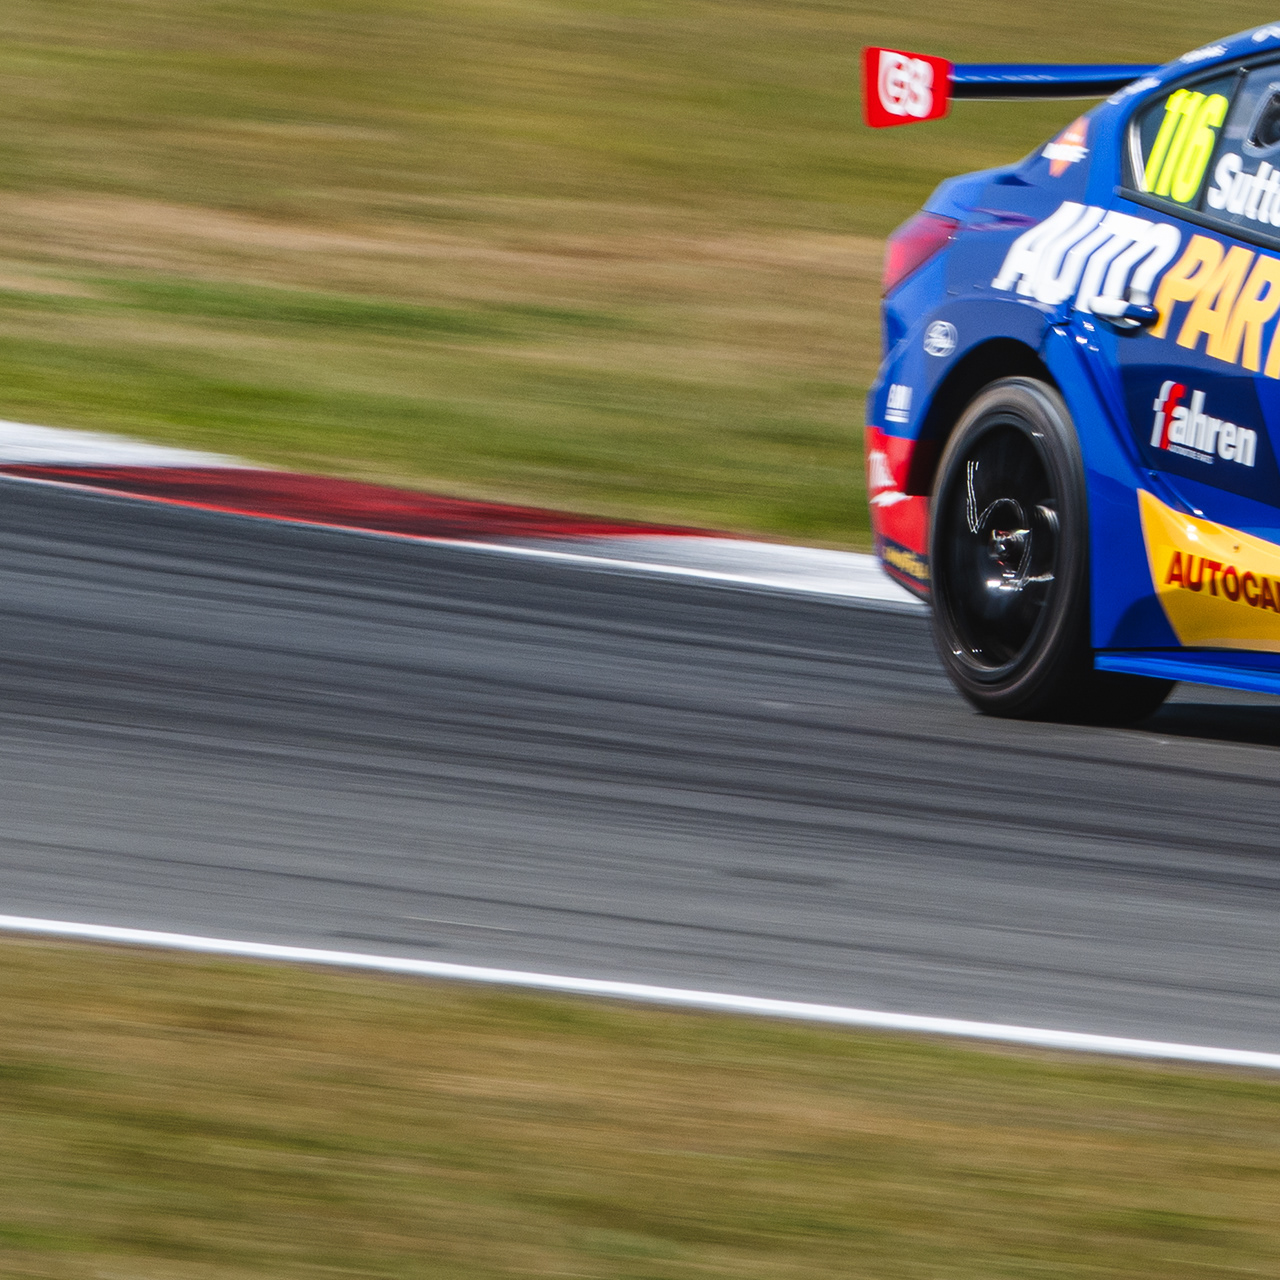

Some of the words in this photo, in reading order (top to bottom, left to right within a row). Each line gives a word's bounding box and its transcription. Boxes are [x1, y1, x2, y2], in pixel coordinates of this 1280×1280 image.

[1142, 88, 1229, 203] 116
[991, 201, 1182, 318] AUTO
[1150, 380, 1258, 467] fahren
